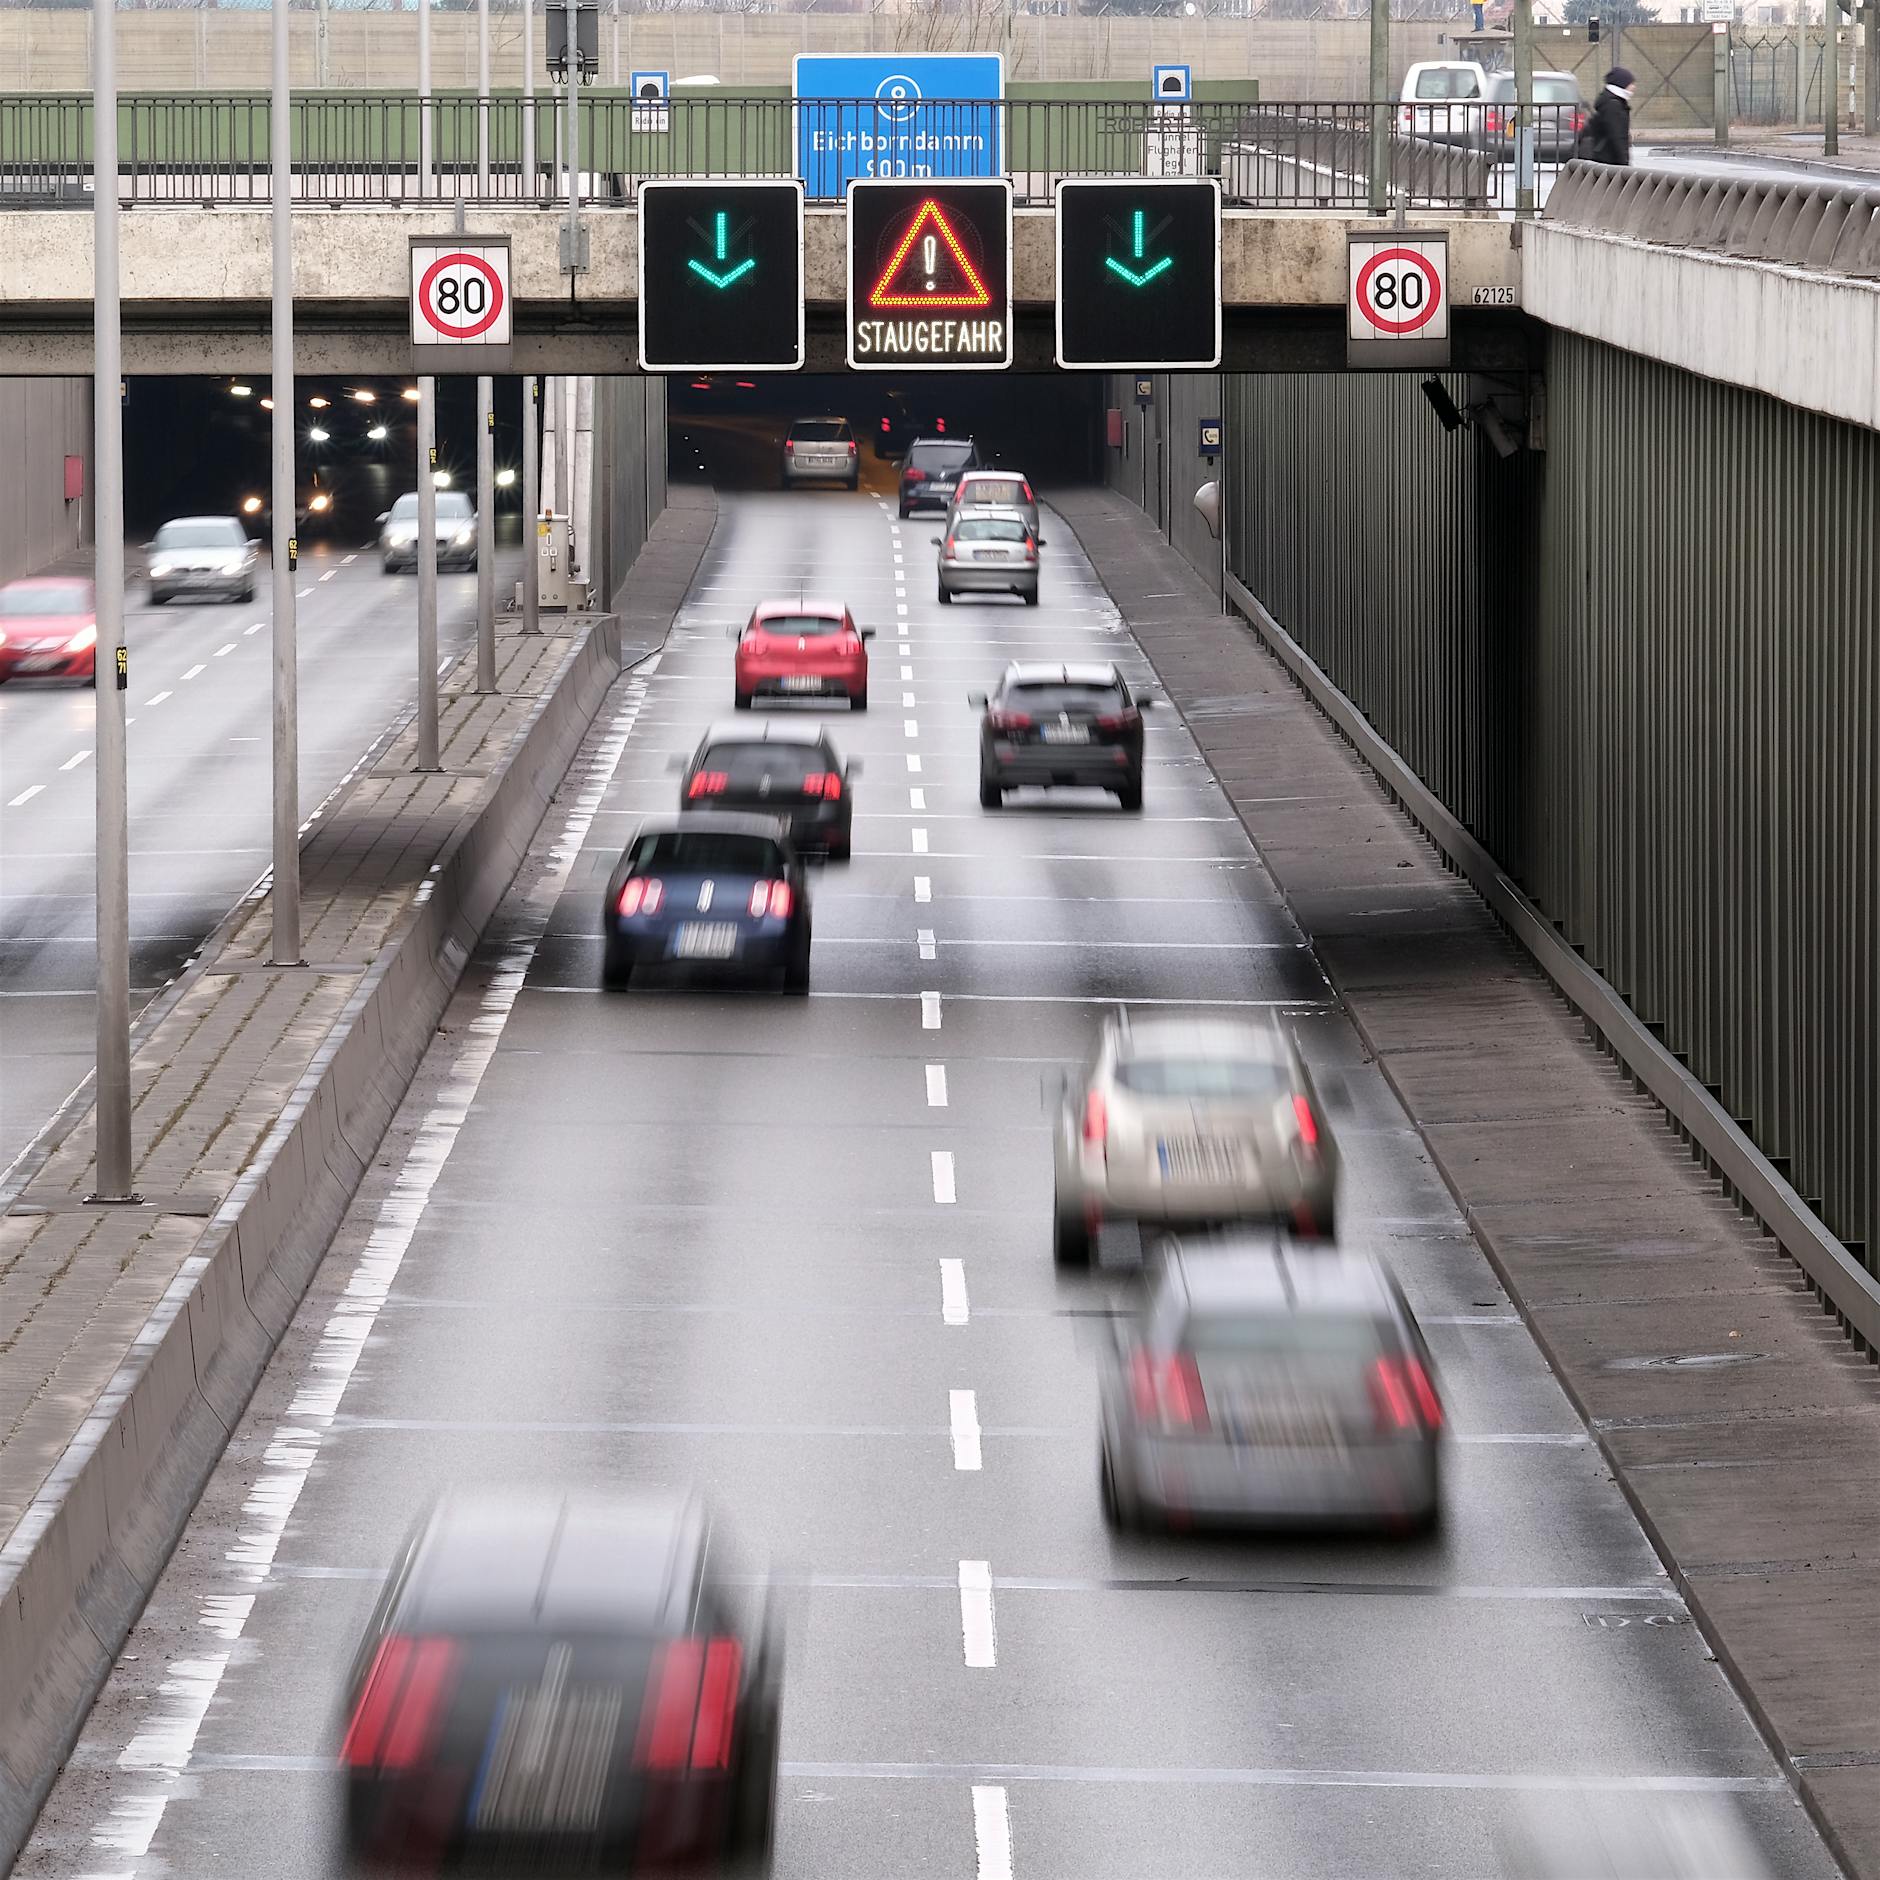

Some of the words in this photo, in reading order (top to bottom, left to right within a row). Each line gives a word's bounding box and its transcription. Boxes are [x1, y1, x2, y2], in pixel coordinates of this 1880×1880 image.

[813, 130, 984, 151] Eichborndamm
[438, 277, 485, 315] 80
[1374, 272, 1423, 310] 80
[1474, 287, 1514, 304] 62125
[857, 320, 1003, 353] STAUGEFAHR
[117, 649, 127, 661] 62
[118, 661, 127, 674] 71
